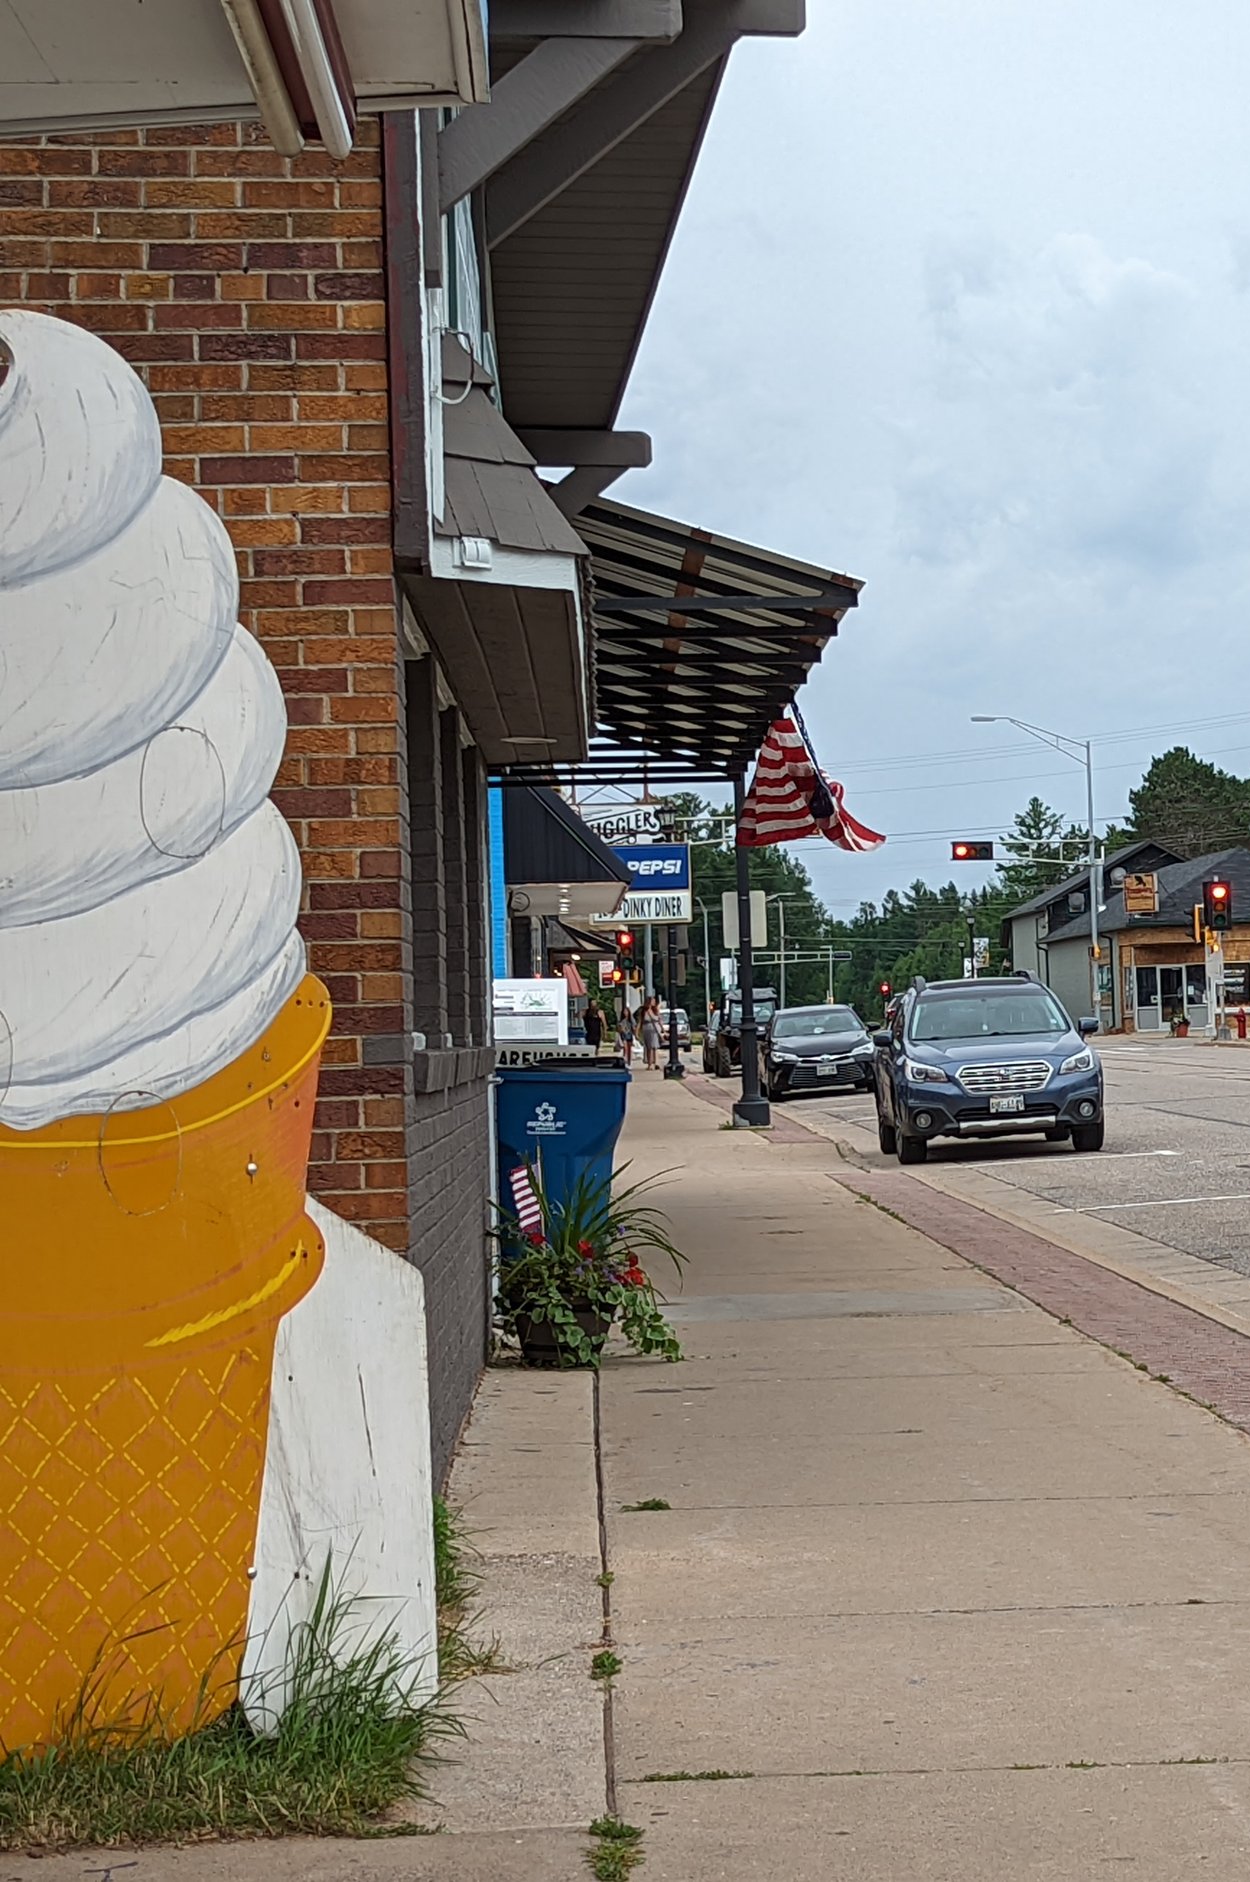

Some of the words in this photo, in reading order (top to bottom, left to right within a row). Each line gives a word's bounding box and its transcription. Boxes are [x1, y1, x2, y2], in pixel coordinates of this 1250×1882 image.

[590, 806, 663, 839] UGGLERS
[627, 860, 682, 875] PEPSI
[655, 896, 682, 917] DINER
